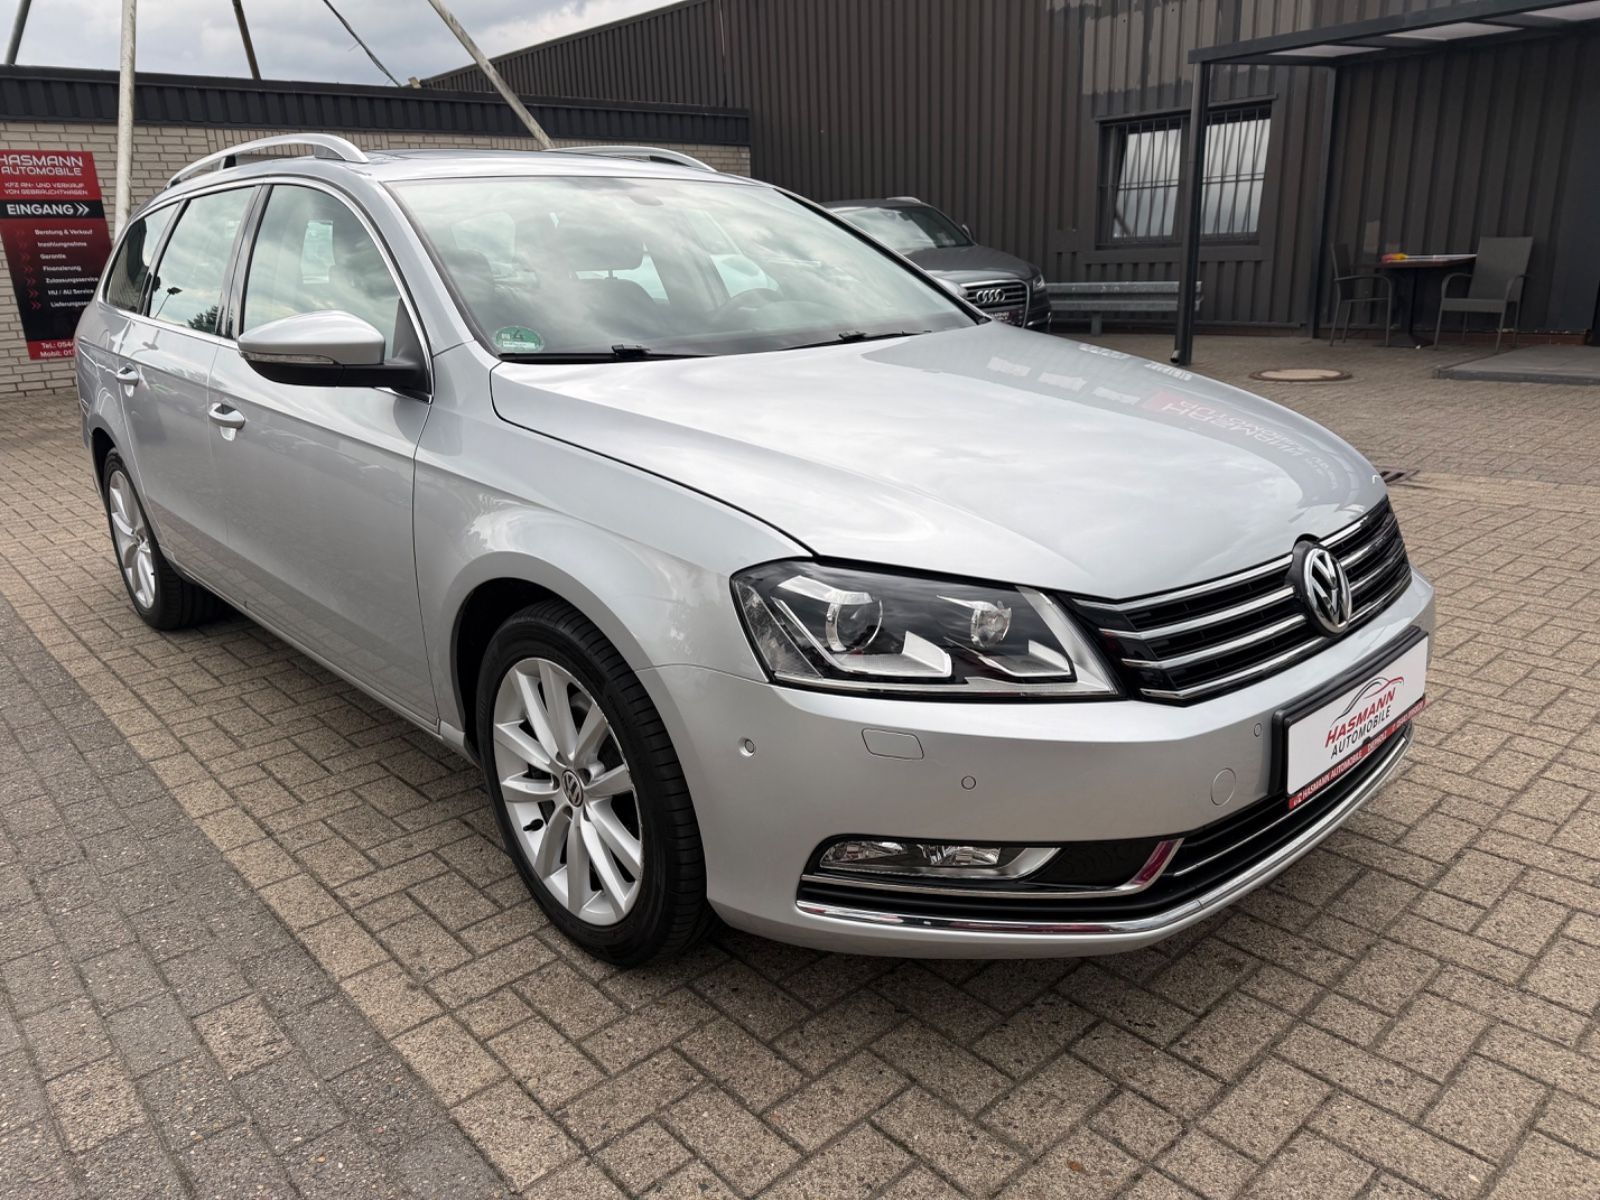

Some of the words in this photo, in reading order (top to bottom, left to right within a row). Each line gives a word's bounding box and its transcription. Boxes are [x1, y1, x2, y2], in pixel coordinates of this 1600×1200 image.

[0, 154, 83, 167] HASMANN
[1, 166, 82, 176] AUTOMOBILE
[6, 203, 74, 215] EINGANG
[1325, 687, 1396, 748] HASMANN
[1331, 705, 1391, 760] AUTOMOBILE
